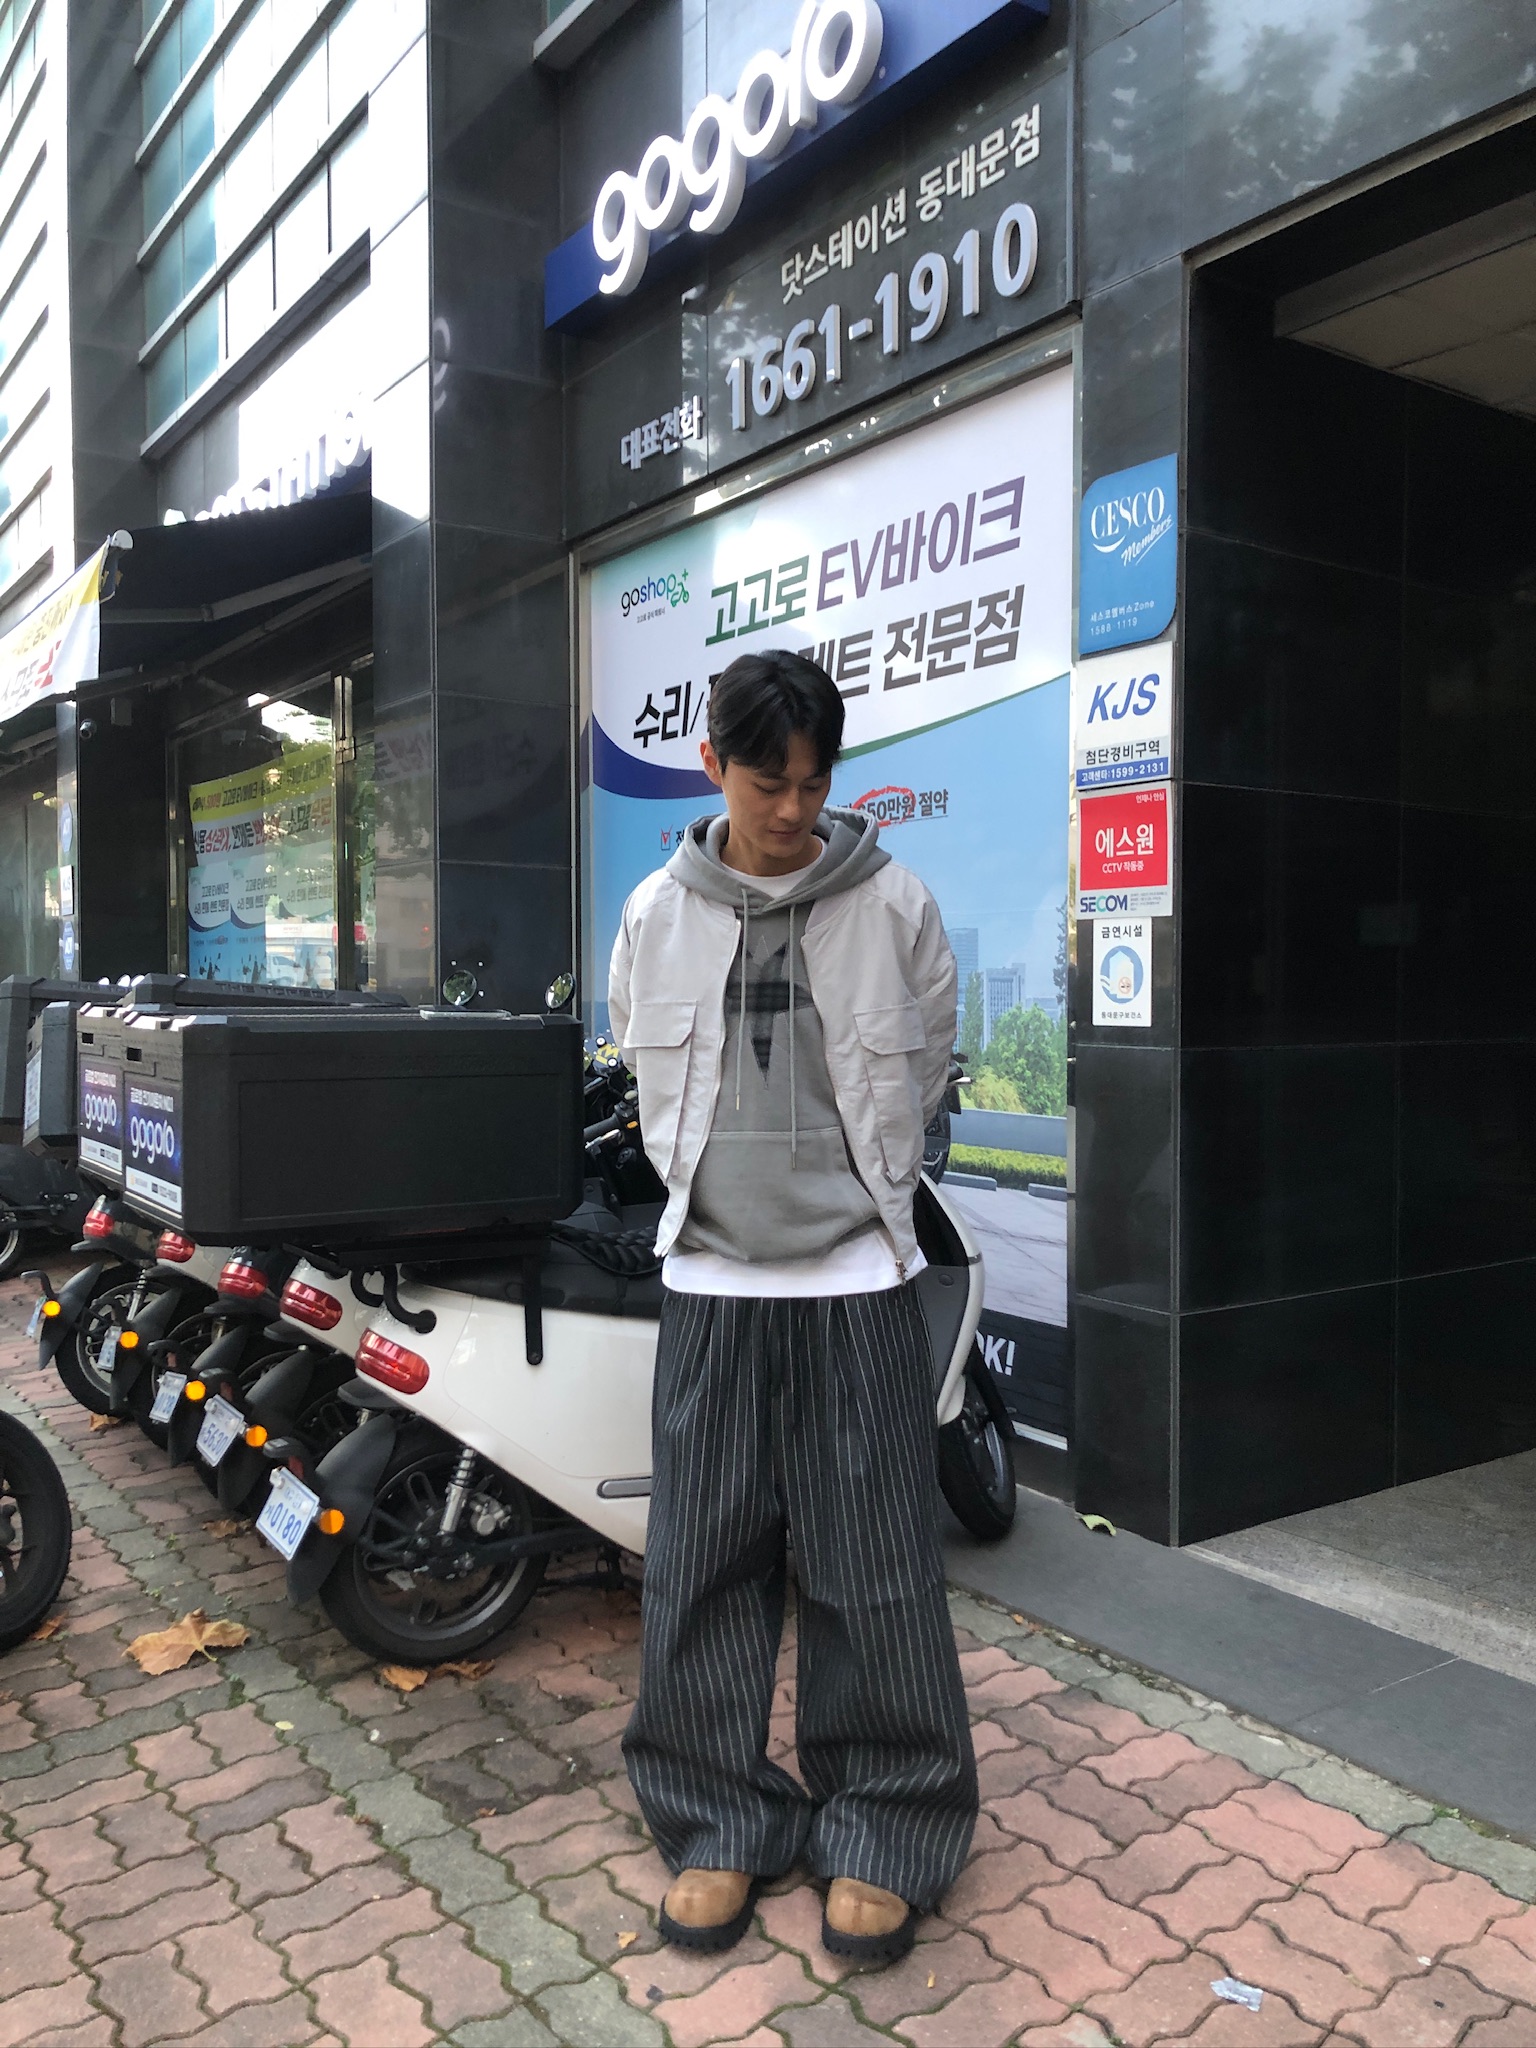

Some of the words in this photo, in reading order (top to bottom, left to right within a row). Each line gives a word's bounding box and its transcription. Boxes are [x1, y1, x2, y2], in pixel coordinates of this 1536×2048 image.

[781, 188, 907, 304] 닷스테이션
[915, 104, 1042, 222] 동대문점
[725, 202, 1038, 431] 1661-1910
[620, 396, 703, 469] 대표전화
[1090, 486, 1165, 540] CESCO
[1120, 513, 1173, 567] Members
[882, 584, 1026, 692] 전문점
[1090, 622, 1112, 637] 1588
[1117, 616, 1138, 630] 1119
[1087, 673, 1160, 724] KJS
[1086, 740, 1160, 766] 첨단경비구역
[919, 788, 949, 817] 절약
[1095, 823, 1154, 858] 에스원
[1102, 863, 1123, 874] CCTV
[1123, 860, 1145, 872] 작동중
[1080, 894, 1128, 913] SECOM
[1101, 924, 1143, 940] 금연시설
[976, 1329, 1015, 1376] K!
